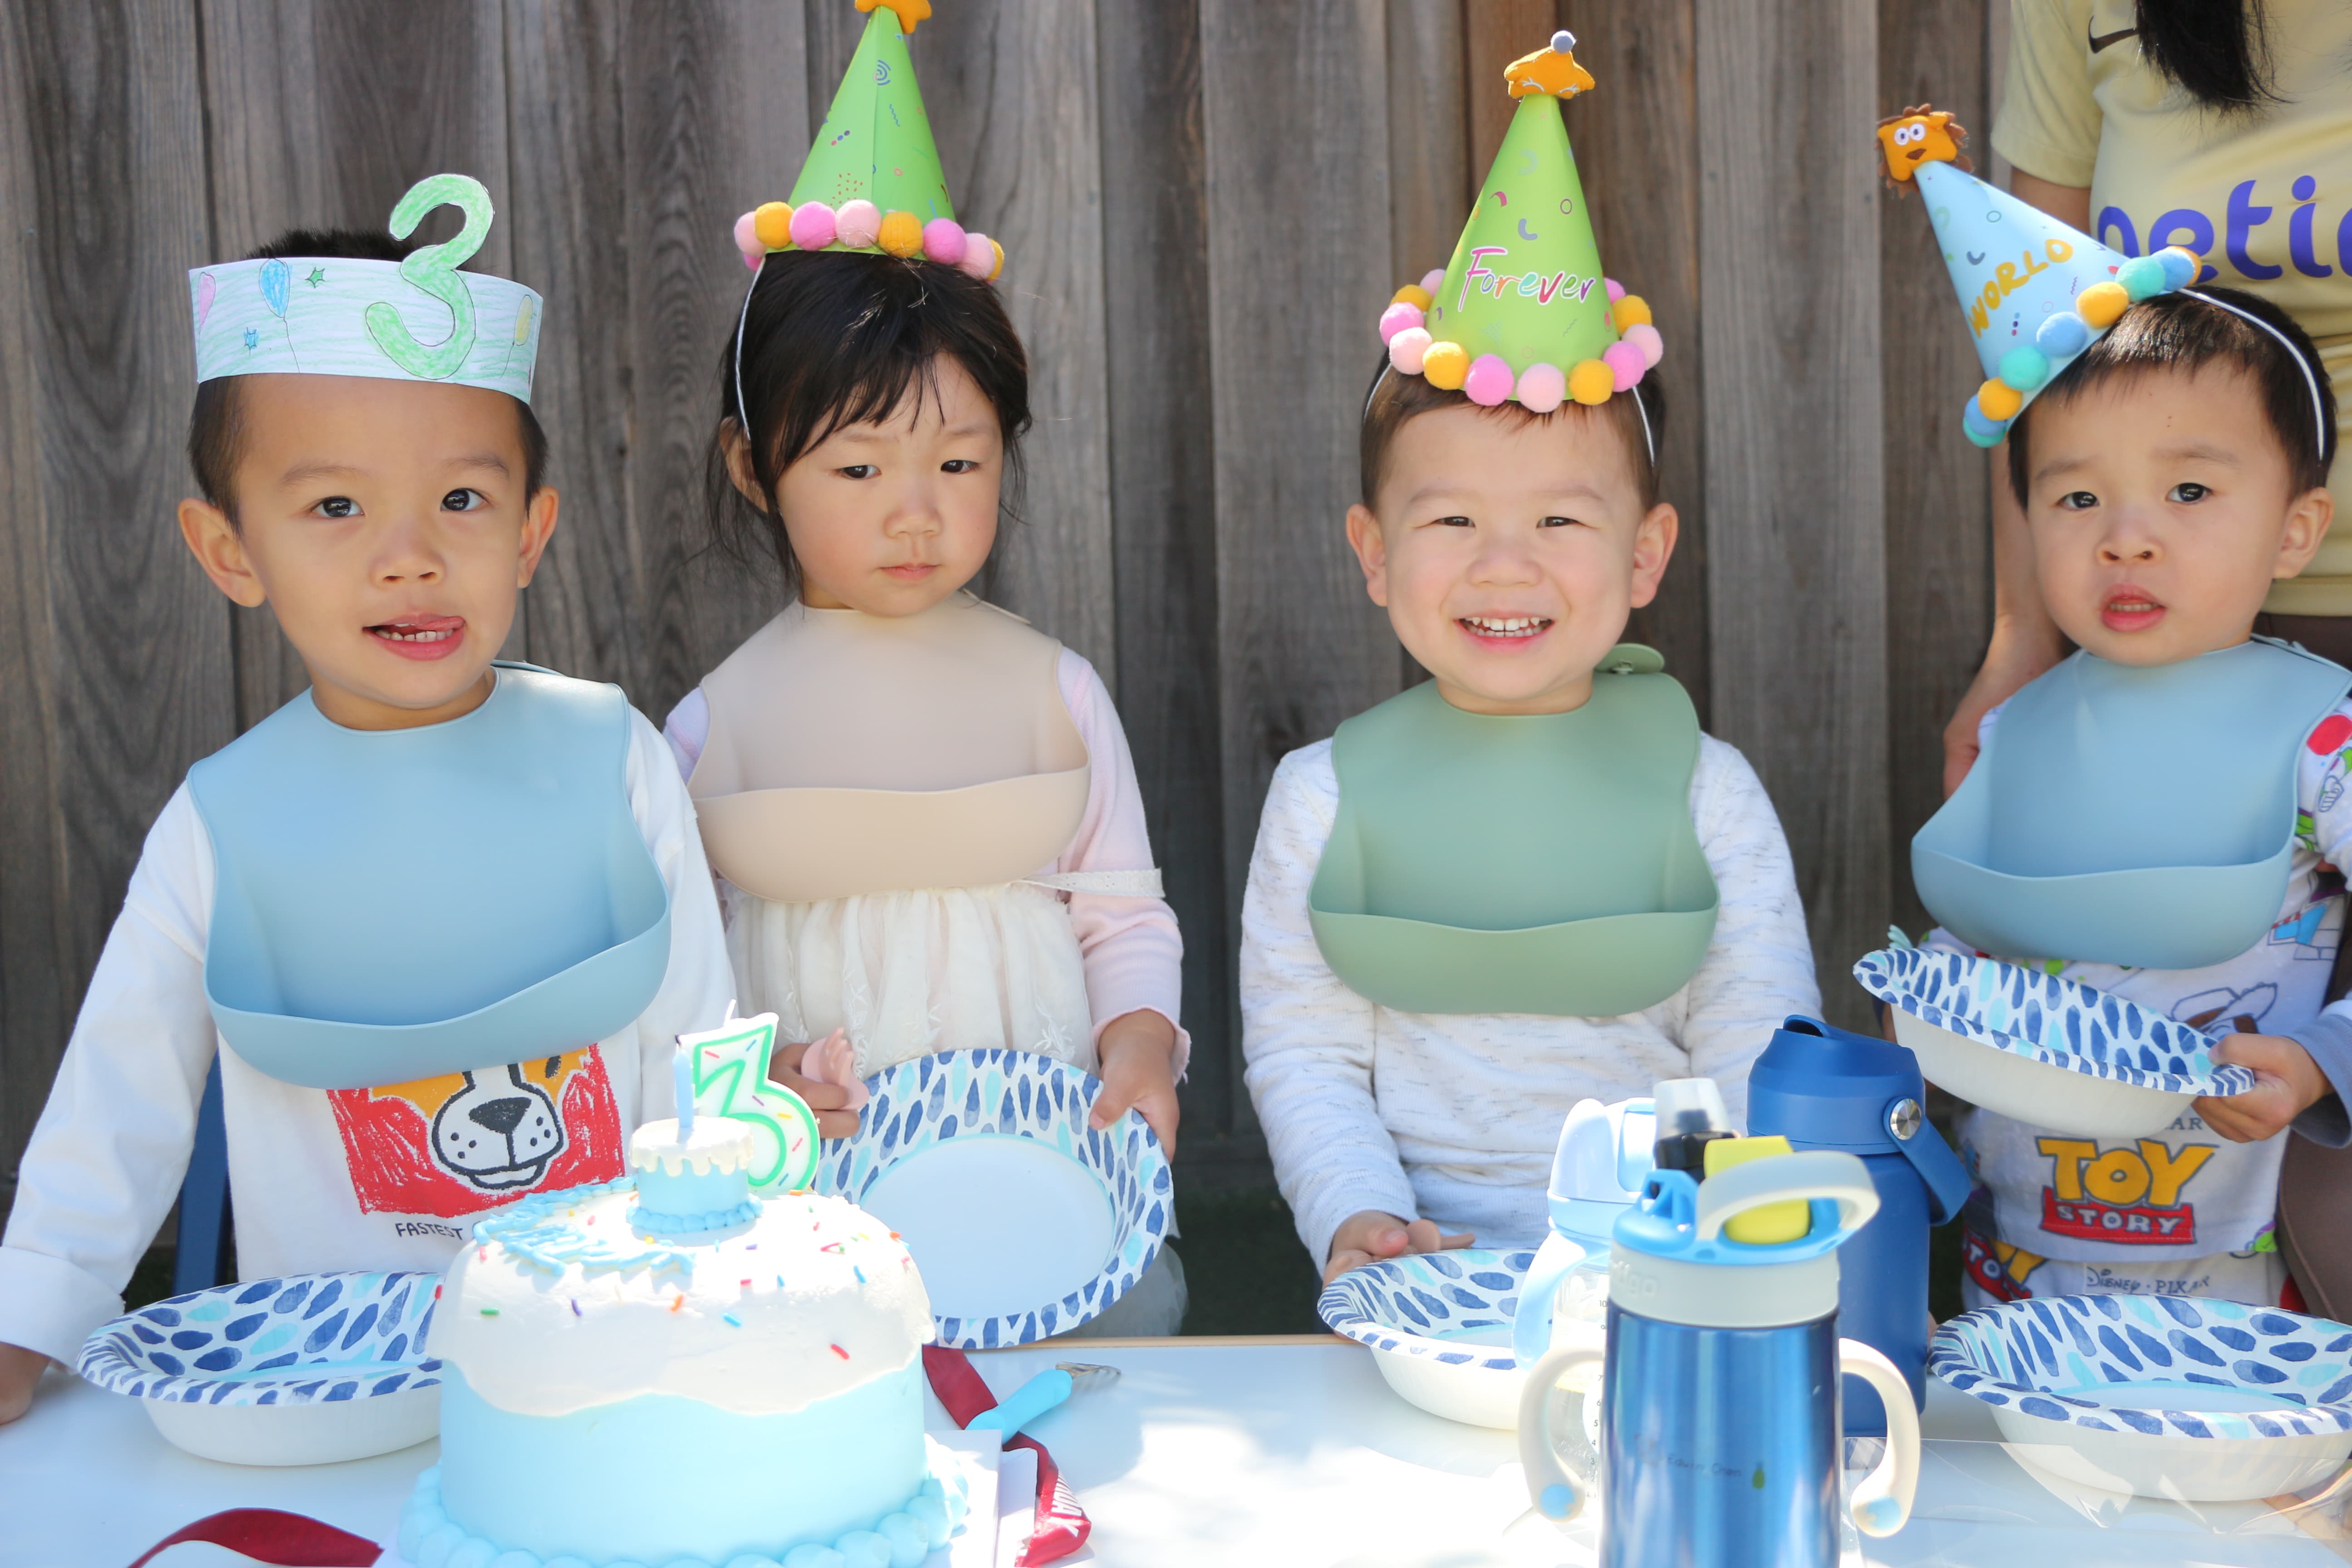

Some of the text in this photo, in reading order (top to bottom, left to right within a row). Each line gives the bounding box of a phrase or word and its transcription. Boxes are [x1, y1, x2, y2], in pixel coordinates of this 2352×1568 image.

[366, 173, 495, 380] 3
[1458, 246, 1595, 312] Forever
[2035, 1136, 2220, 1208] TOY
[395, 1222, 463, 1241] FASTEST
[2055, 1205, 2185, 1235] STORY
